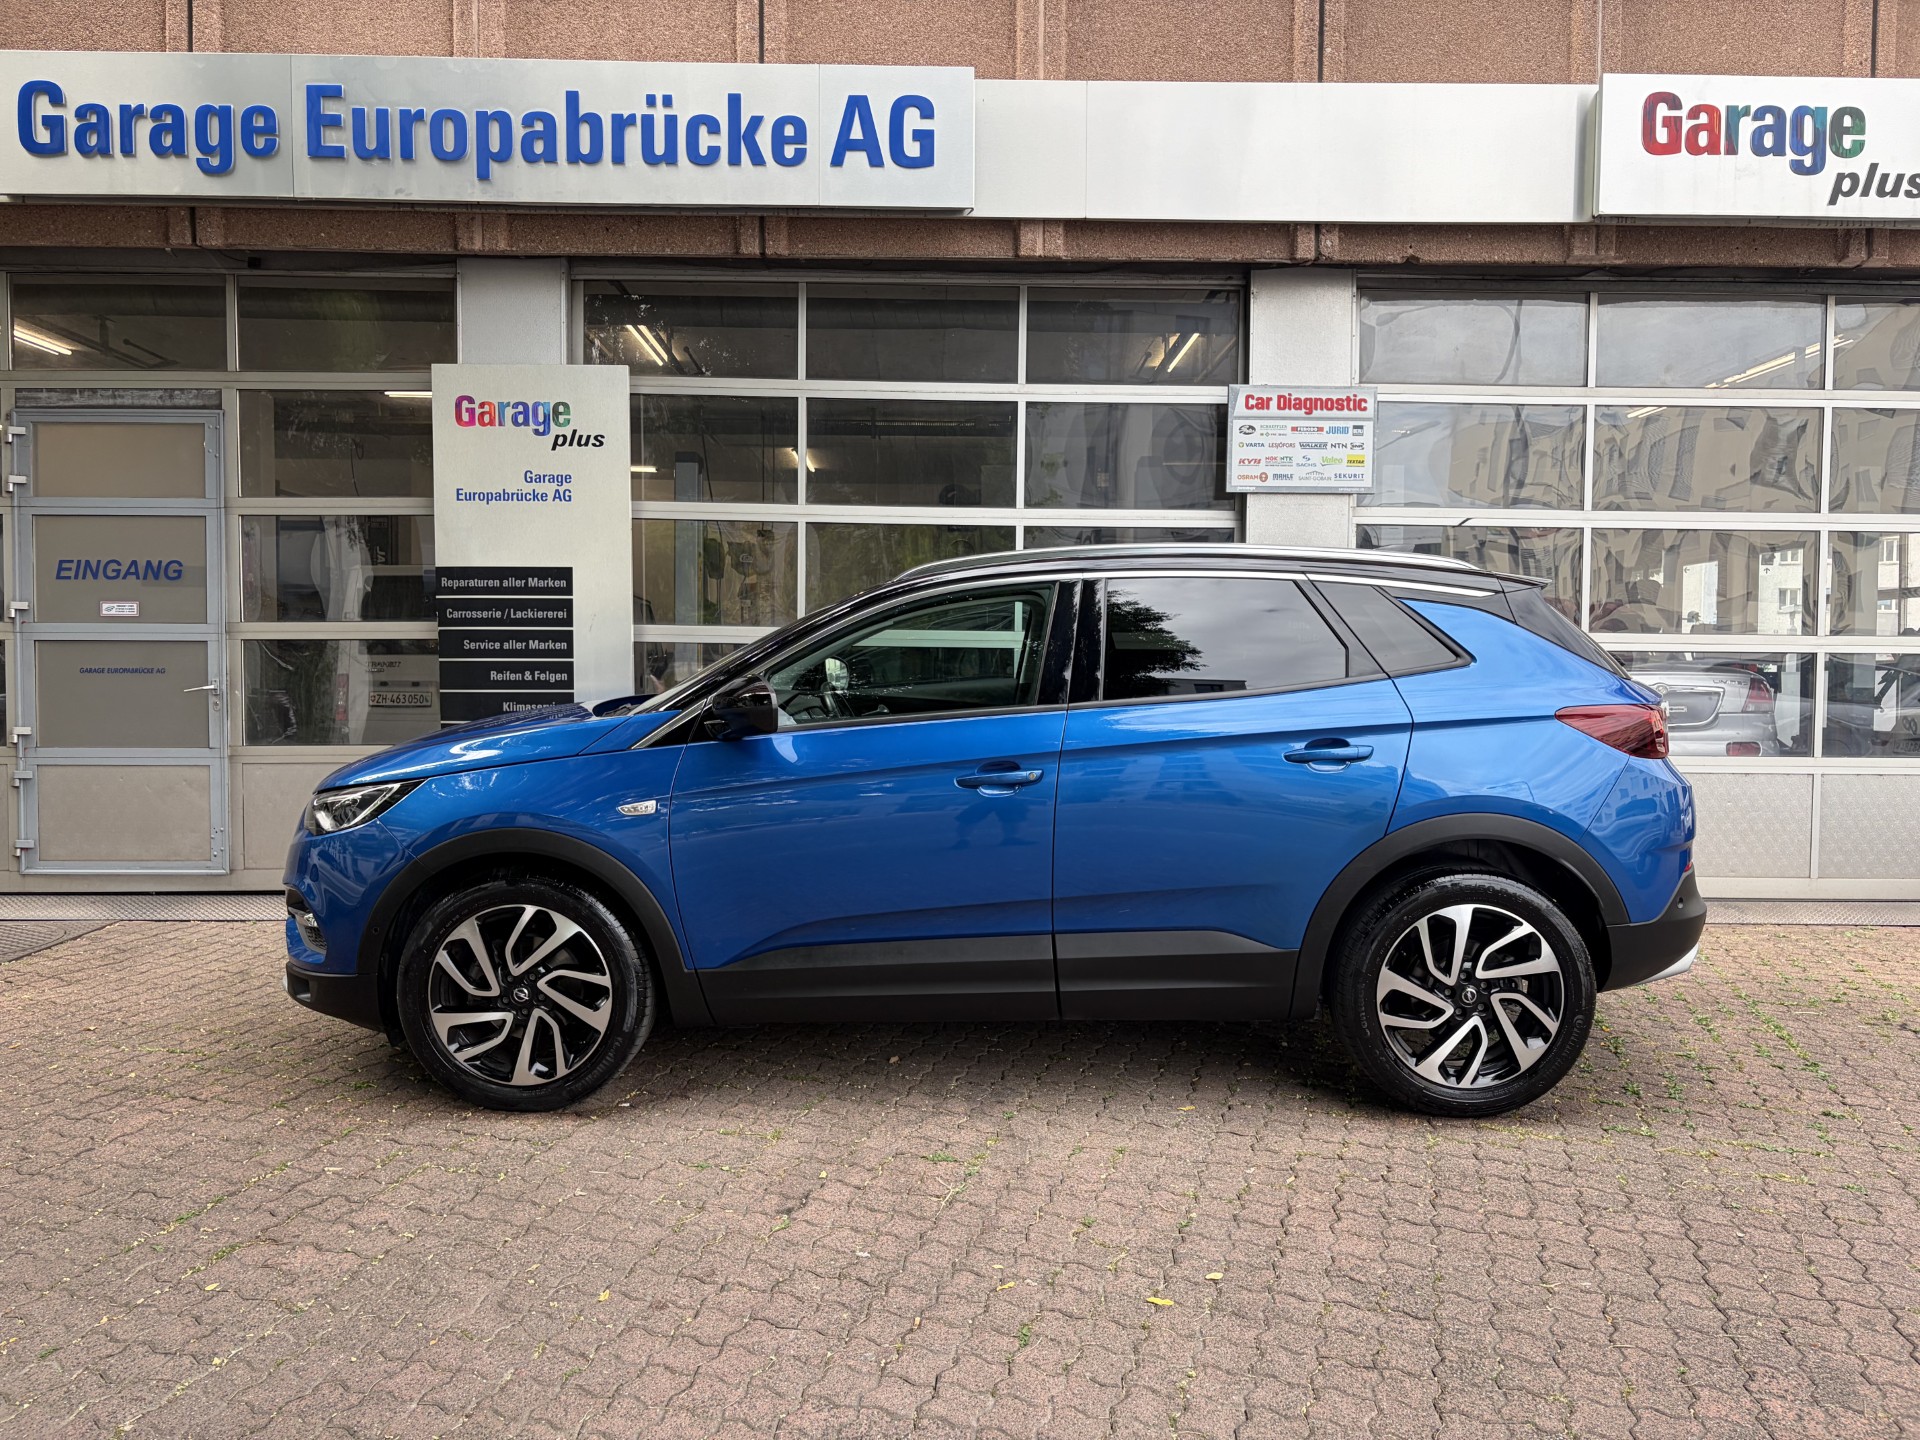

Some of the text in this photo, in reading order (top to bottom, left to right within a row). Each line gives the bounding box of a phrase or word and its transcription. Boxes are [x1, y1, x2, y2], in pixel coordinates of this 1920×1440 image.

[17, 80, 936, 180] Garage Europabrücke AG
[1641, 91, 1866, 176] Garage
[1827, 163, 1920, 206] plus
[1244, 393, 1368, 416] Car Diagnostic
[455, 395, 571, 436] Garage
[1326, 426, 1350, 435] JURID
[551, 429, 605, 451] plus
[1321, 456, 1343, 464] Valeo
[524, 470, 572, 486] Garage
[456, 488, 572, 505] Europabrücke AG
[55, 559, 184, 581] EINGANG
[441, 577, 567, 590] Reparaturen aller Marken
[446, 608, 567, 619] Carrosserie / Lackiererei
[463, 639, 567, 650] Service aller Marken
[107, 666, 155, 674] EUROPABRÜCKE
[490, 671, 568, 683] Reifen & Felgen
